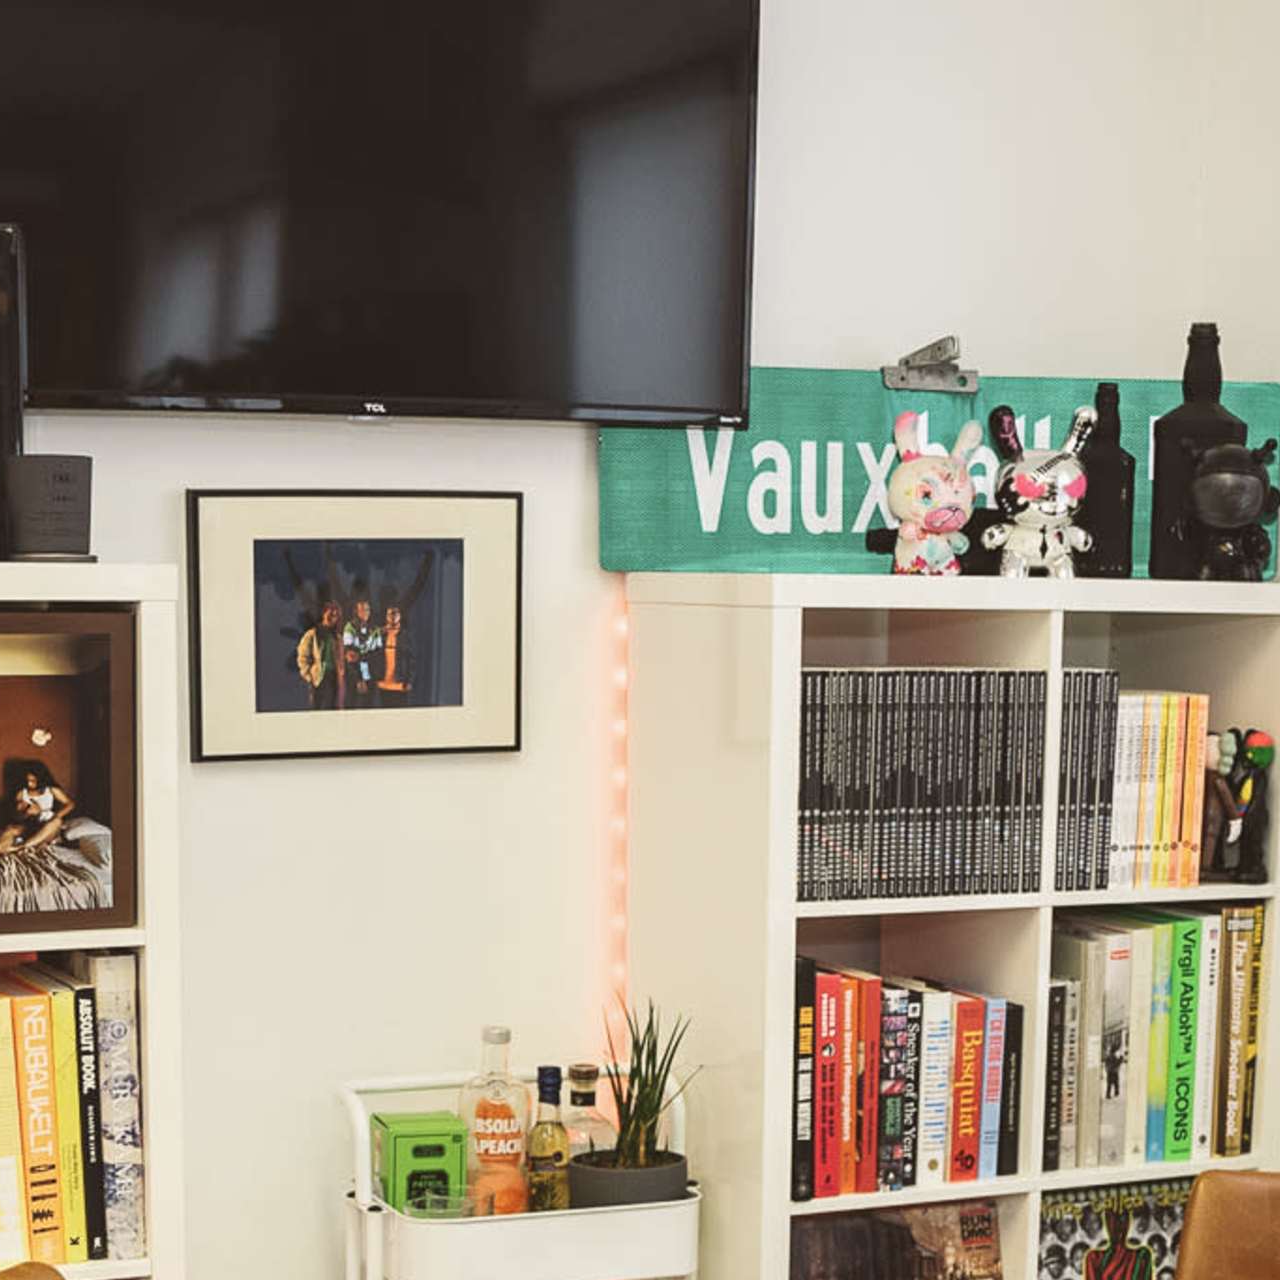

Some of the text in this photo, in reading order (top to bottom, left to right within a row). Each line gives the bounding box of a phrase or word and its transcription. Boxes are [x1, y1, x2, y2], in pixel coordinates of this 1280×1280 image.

[363, 403, 387, 413] TCL
[1176, 928, 1198, 978] Virgil
[78, 998, 95, 1053] ABSOLUT
[1225, 939, 1249, 1138] The Ultimate Sneaker Book
[22, 1003, 54, 1157] NEUBAUWELT
[841, 1064, 852, 1142] Photographers
[903, 1022, 921, 1161] Sneaker of the Year
[953, 1028, 984, 1138] Basquiat
[1173, 1076, 1191, 1142] ICONS
[960, 1213, 993, 1228] RUN
[962, 1226, 993, 1243] DMC
